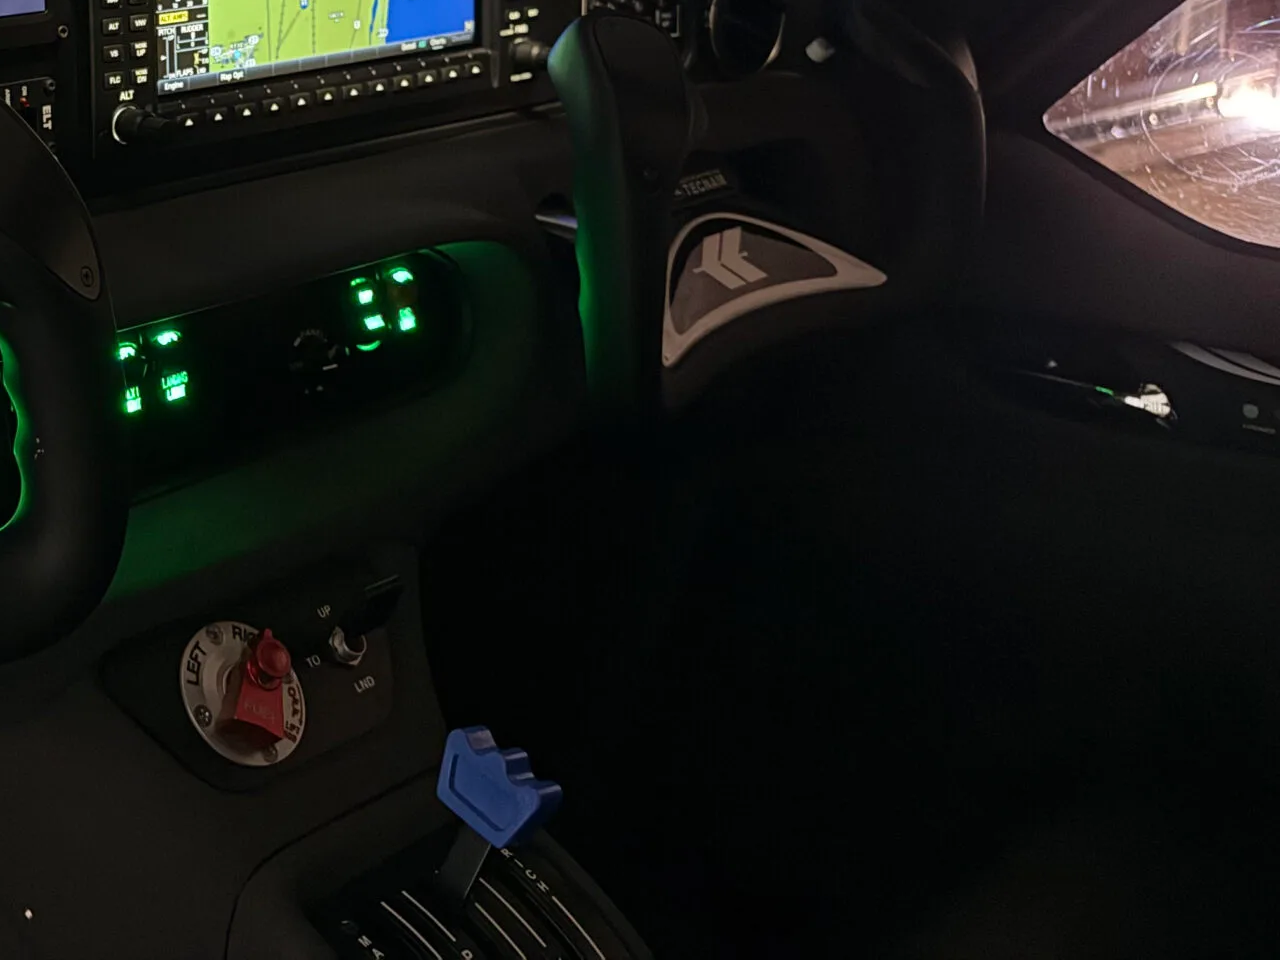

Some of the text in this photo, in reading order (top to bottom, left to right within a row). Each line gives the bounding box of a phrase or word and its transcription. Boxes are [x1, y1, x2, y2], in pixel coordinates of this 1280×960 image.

[108, 22, 119, 30] ALT
[120, 90, 135, 100] ALT
[316, 604, 332, 619] UP
[186, 640, 207, 687] LEFT
[353, 675, 376, 694] LND
[499, 847, 550, 892] RICH
